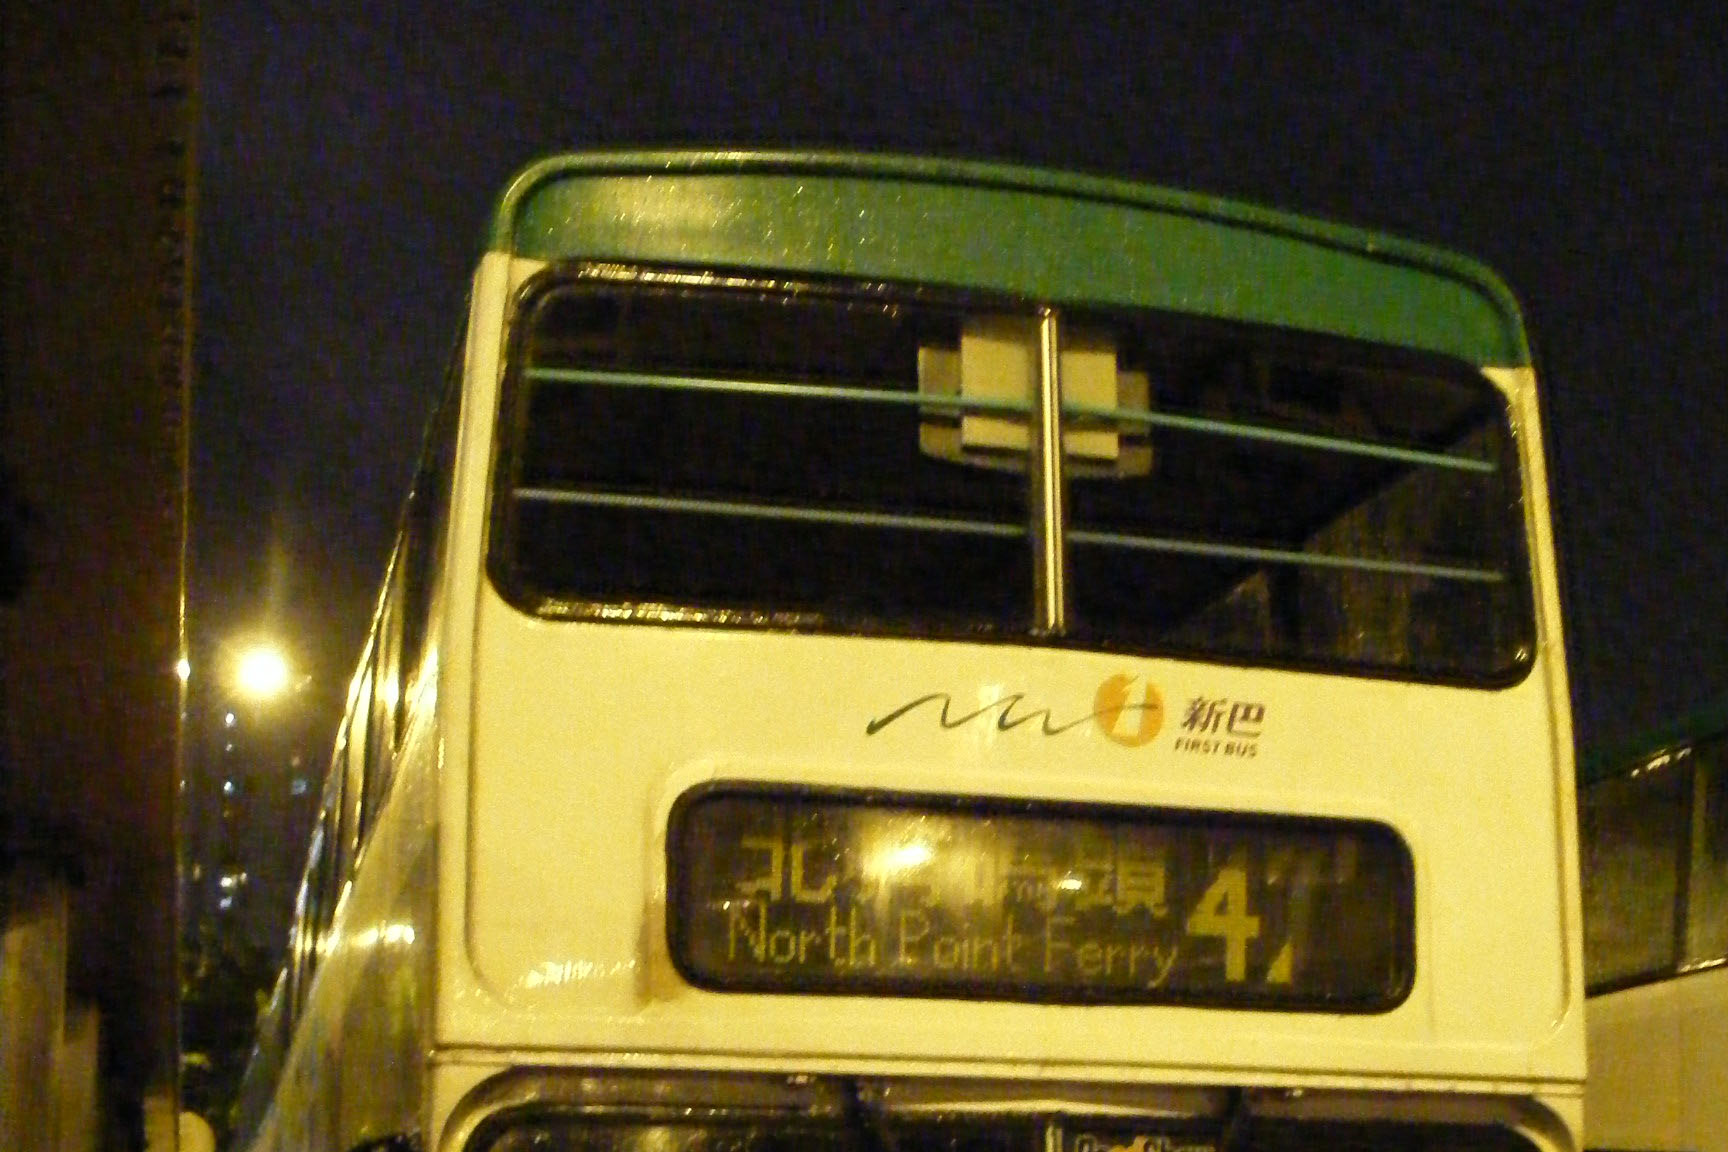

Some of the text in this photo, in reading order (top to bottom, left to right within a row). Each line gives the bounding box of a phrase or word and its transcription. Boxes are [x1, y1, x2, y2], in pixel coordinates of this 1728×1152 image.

[1180, 695, 1265, 739] 新巴
[1174, 737, 1257, 757] FIRST BUS
[728, 896, 1179, 989] North Point Ferry
